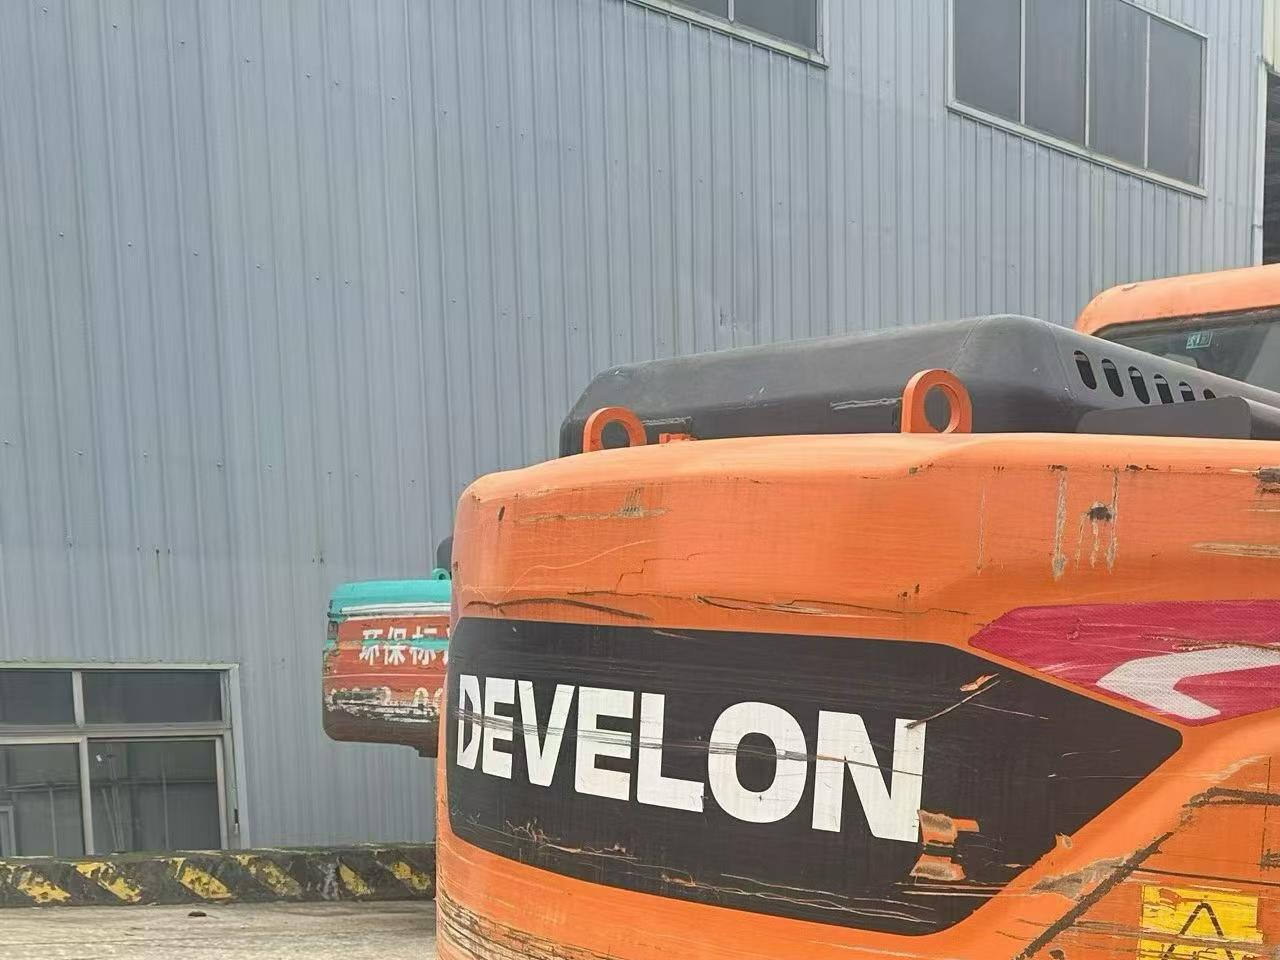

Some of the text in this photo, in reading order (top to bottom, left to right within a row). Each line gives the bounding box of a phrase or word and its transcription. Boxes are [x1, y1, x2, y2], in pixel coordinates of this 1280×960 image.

[359, 626, 450, 666] 环保标
[456, 674, 927, 842] DEVELON
